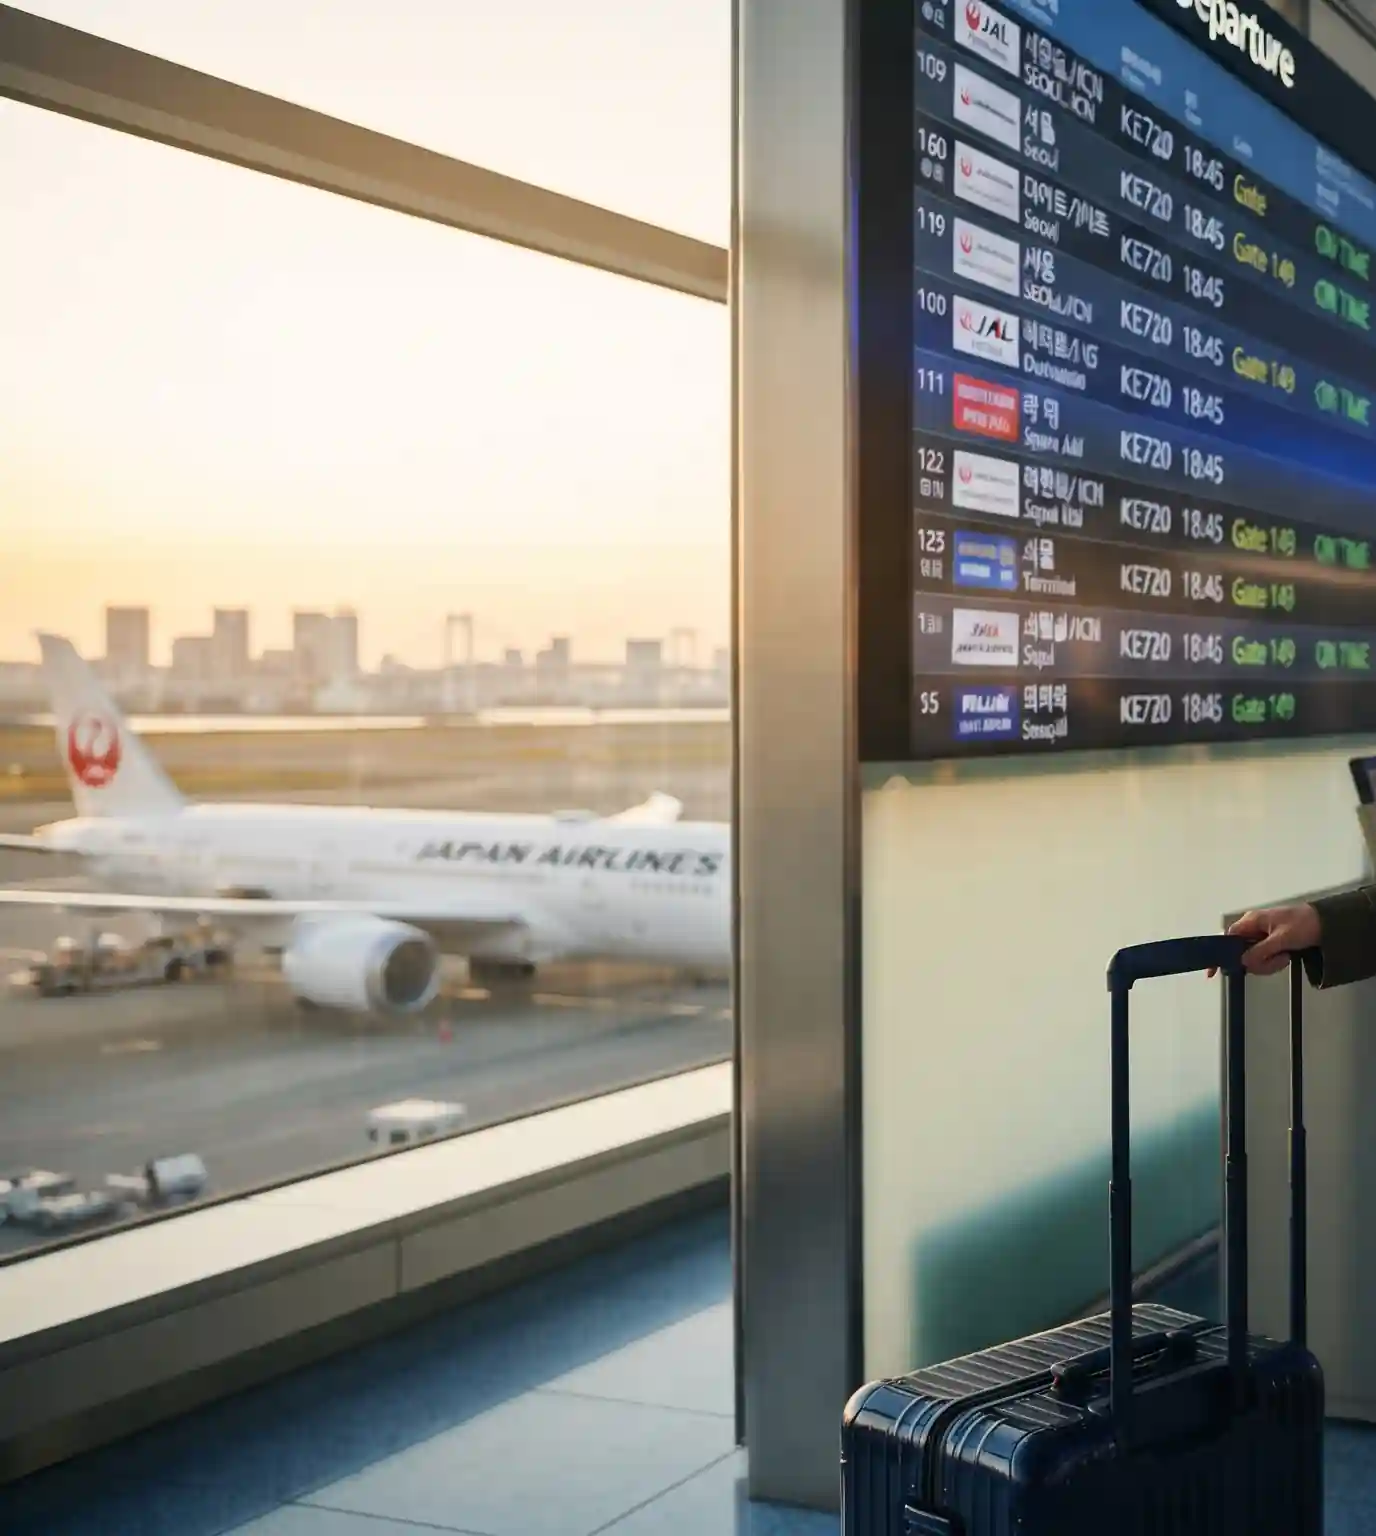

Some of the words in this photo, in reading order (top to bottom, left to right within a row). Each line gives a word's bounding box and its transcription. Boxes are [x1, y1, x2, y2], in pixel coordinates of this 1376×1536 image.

[981, 16, 1010, 47] JAL
[1176, 0, 1295, 88] eparture
[917, 51, 947, 82] 109
[918, 128, 948, 160] 160
[1120, 104, 1174, 160] KE720
[1184, 145, 1224, 191] 18:45
[917, 206, 946, 237] 119
[1120, 170, 1173, 222] KE720
[1184, 204, 1224, 250] 18:45
[1120, 235, 1172, 283] KE720
[1183, 265, 1224, 308] 18:45
[917, 287, 947, 317] 100
[1120, 300, 1172, 346] KE720
[1183, 326, 1224, 366] 18:45
[918, 368, 944, 395] 111
[1120, 365, 1172, 409] KE720
[1183, 387, 1224, 425] 18:45
[918, 448, 945, 474] 122
[1120, 430, 1172, 471] KE720
[1182, 447, 1224, 485] 18:45
[1120, 497, 1172, 534] KE720
[1120, 564, 1172, 597] KE720
[1120, 629, 1172, 661] KE720
[1120, 694, 1172, 725] KE720
